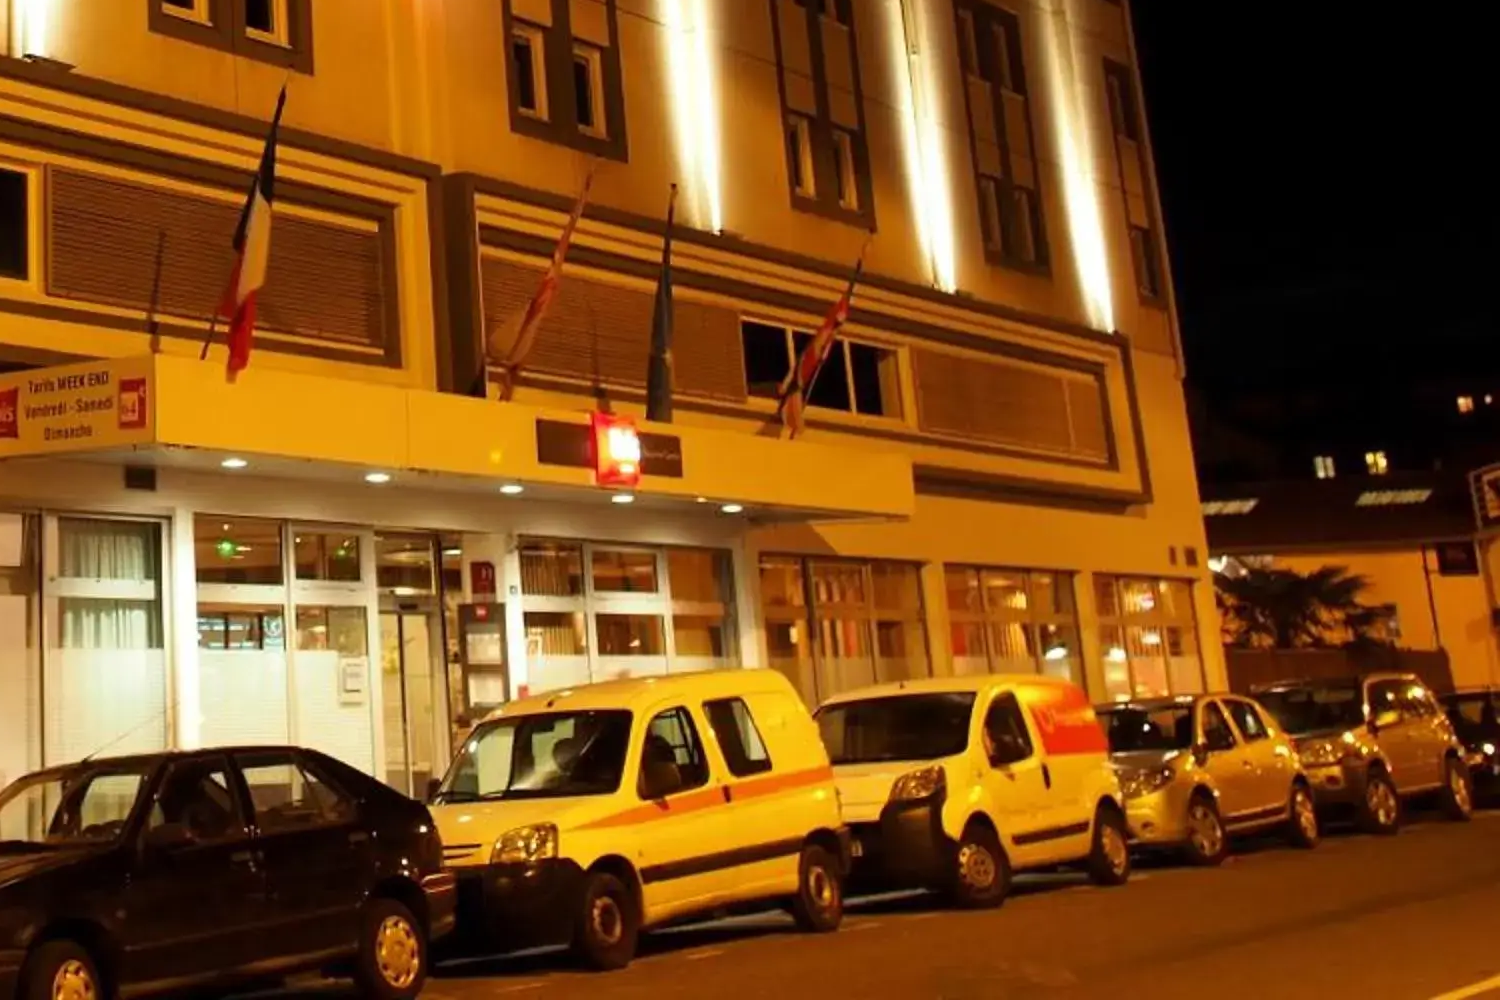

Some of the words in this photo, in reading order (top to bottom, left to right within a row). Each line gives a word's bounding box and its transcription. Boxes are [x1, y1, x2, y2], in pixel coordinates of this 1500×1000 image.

[57, 375, 84, 391] WEEK
[88, 371, 110, 387] END
[24, 401, 67, 420] Vendredi
[75, 395, 114, 414] Samedi
[44, 424, 92, 441] Dimanche
